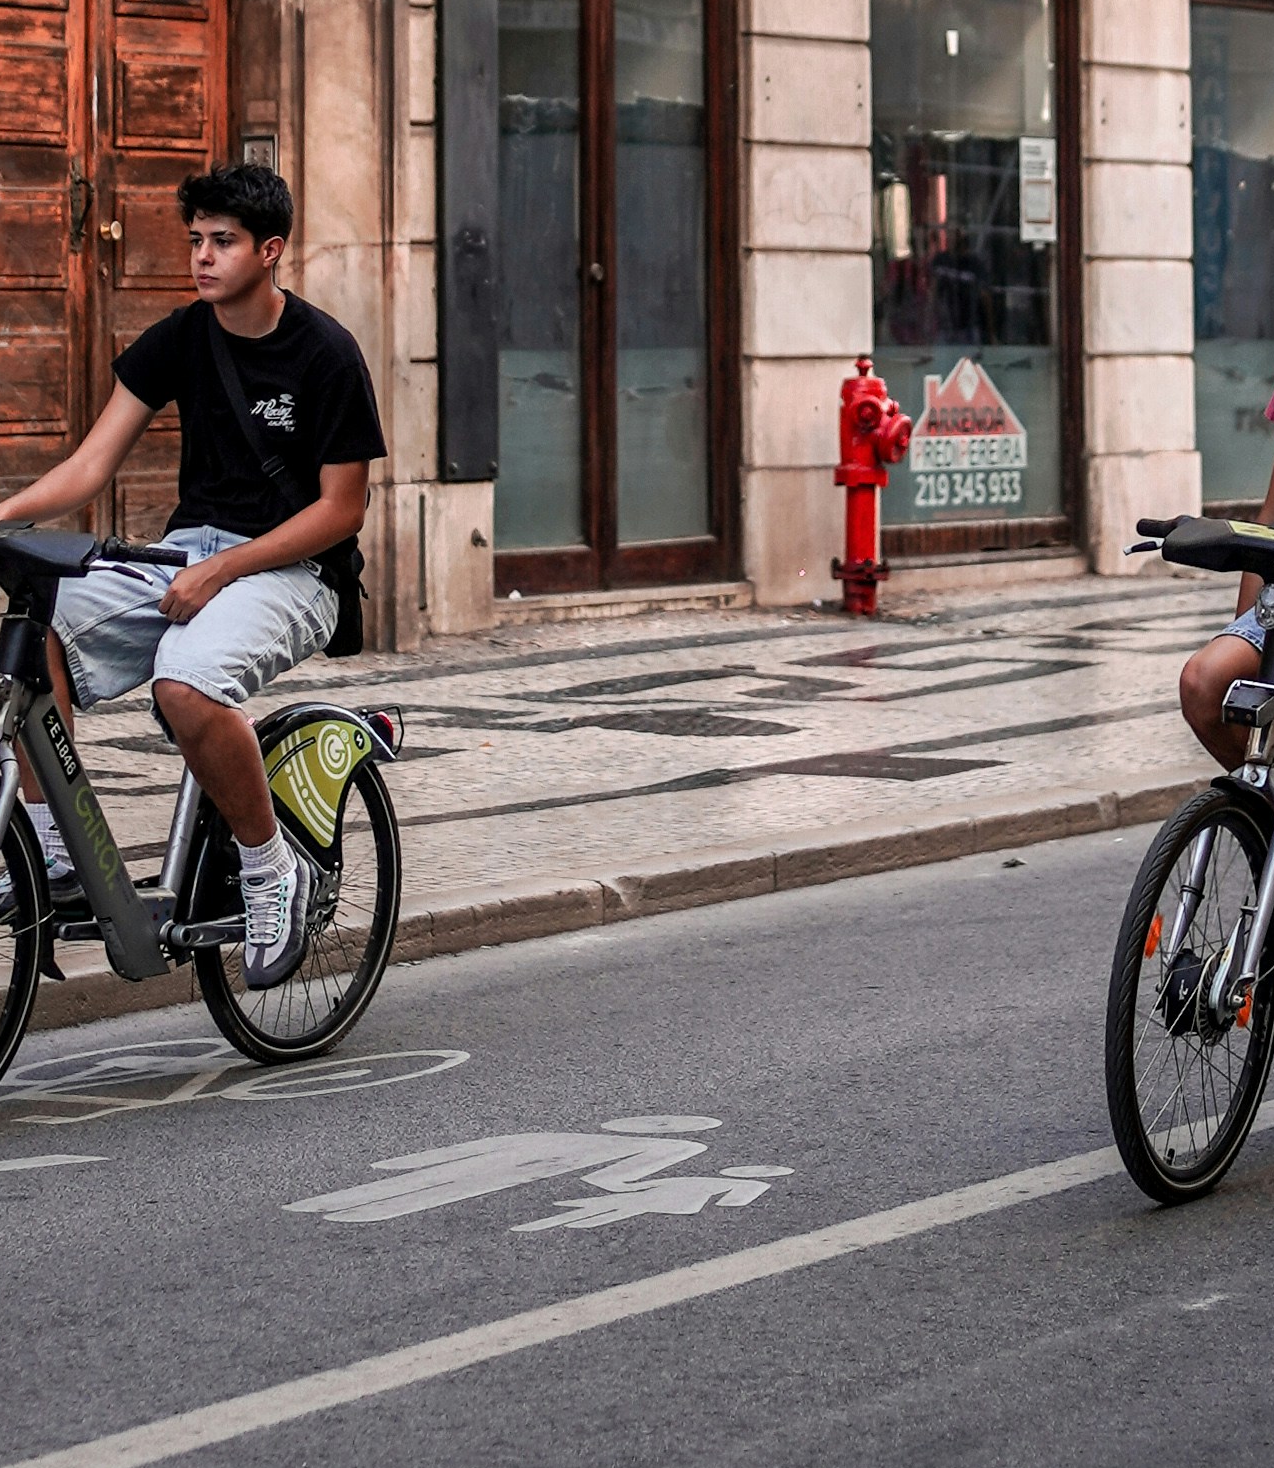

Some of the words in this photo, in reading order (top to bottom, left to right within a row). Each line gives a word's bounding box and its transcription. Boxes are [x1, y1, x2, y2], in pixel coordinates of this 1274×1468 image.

[927, 406, 1005, 433] ARRENDA
[915, 473, 950, 506] 219
[951, 472, 987, 504] 345
[988, 470, 1021, 503] 933
[49, 723, 61, 739] E
